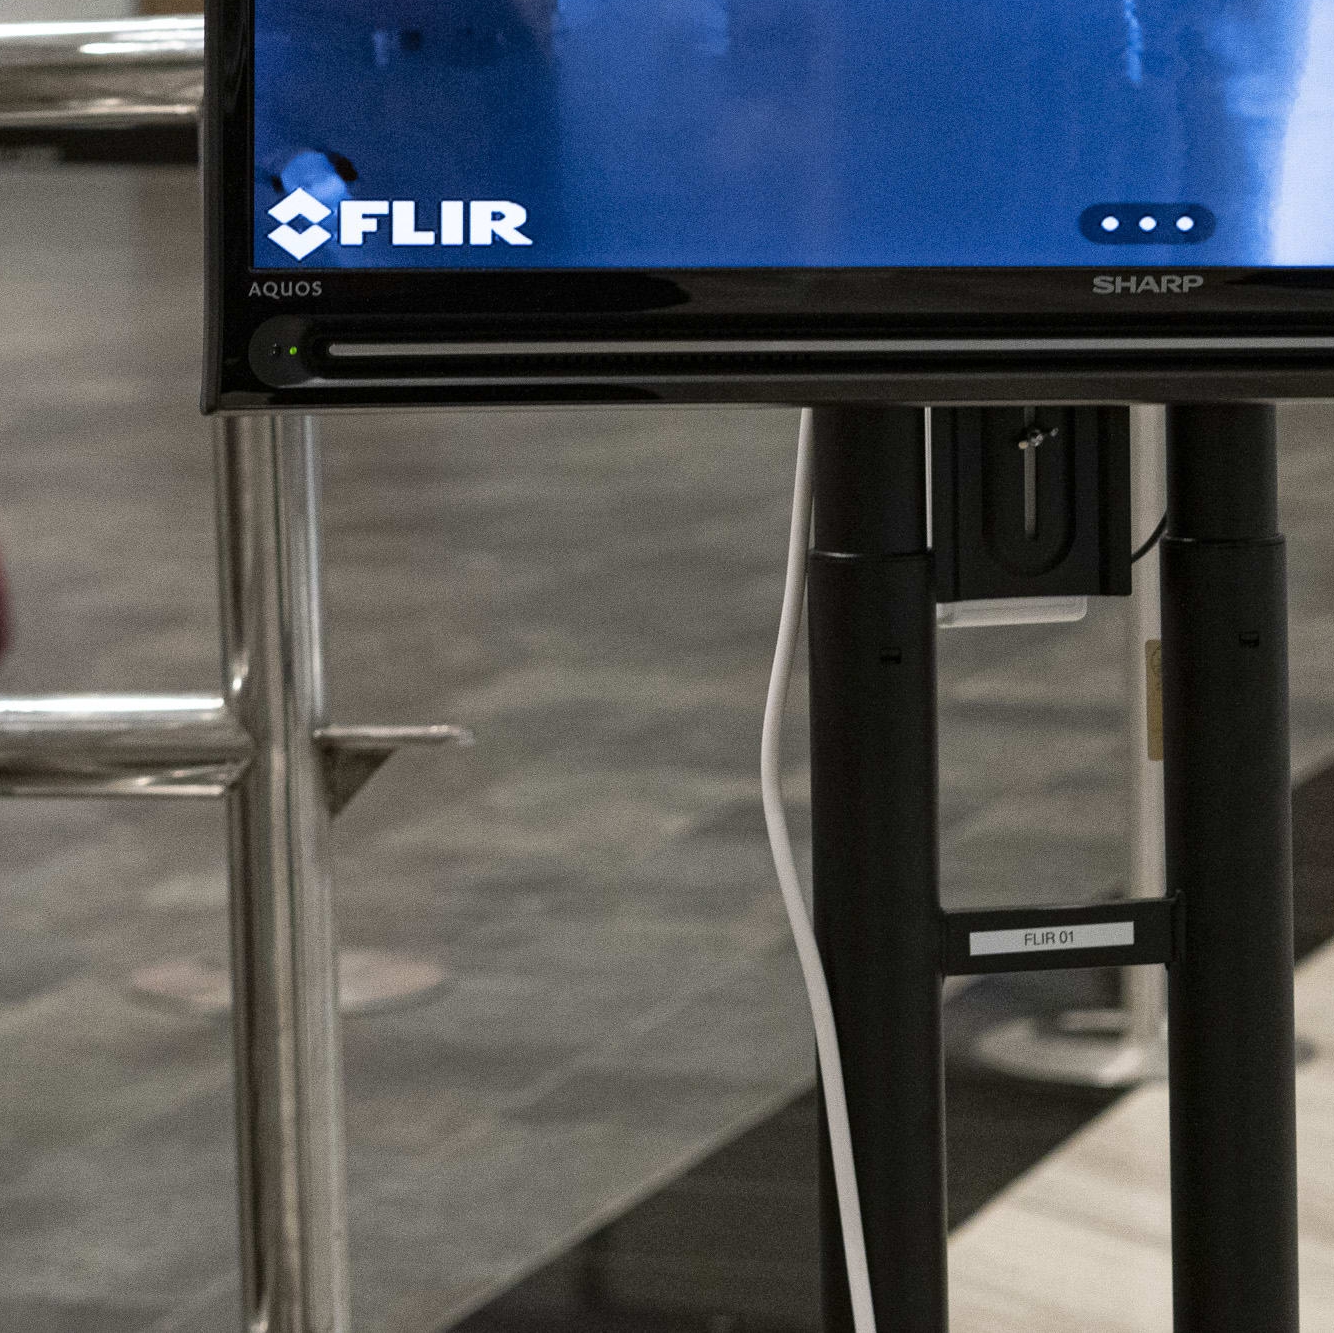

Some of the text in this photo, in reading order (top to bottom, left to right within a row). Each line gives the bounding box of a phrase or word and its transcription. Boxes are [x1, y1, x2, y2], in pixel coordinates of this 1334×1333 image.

[339, 200, 533, 246] FLIR
[248, 281, 323, 298] AQUOS
[1092, 274, 1204, 294] SHARP
[1024, 930, 1074, 946] FLIR 01
